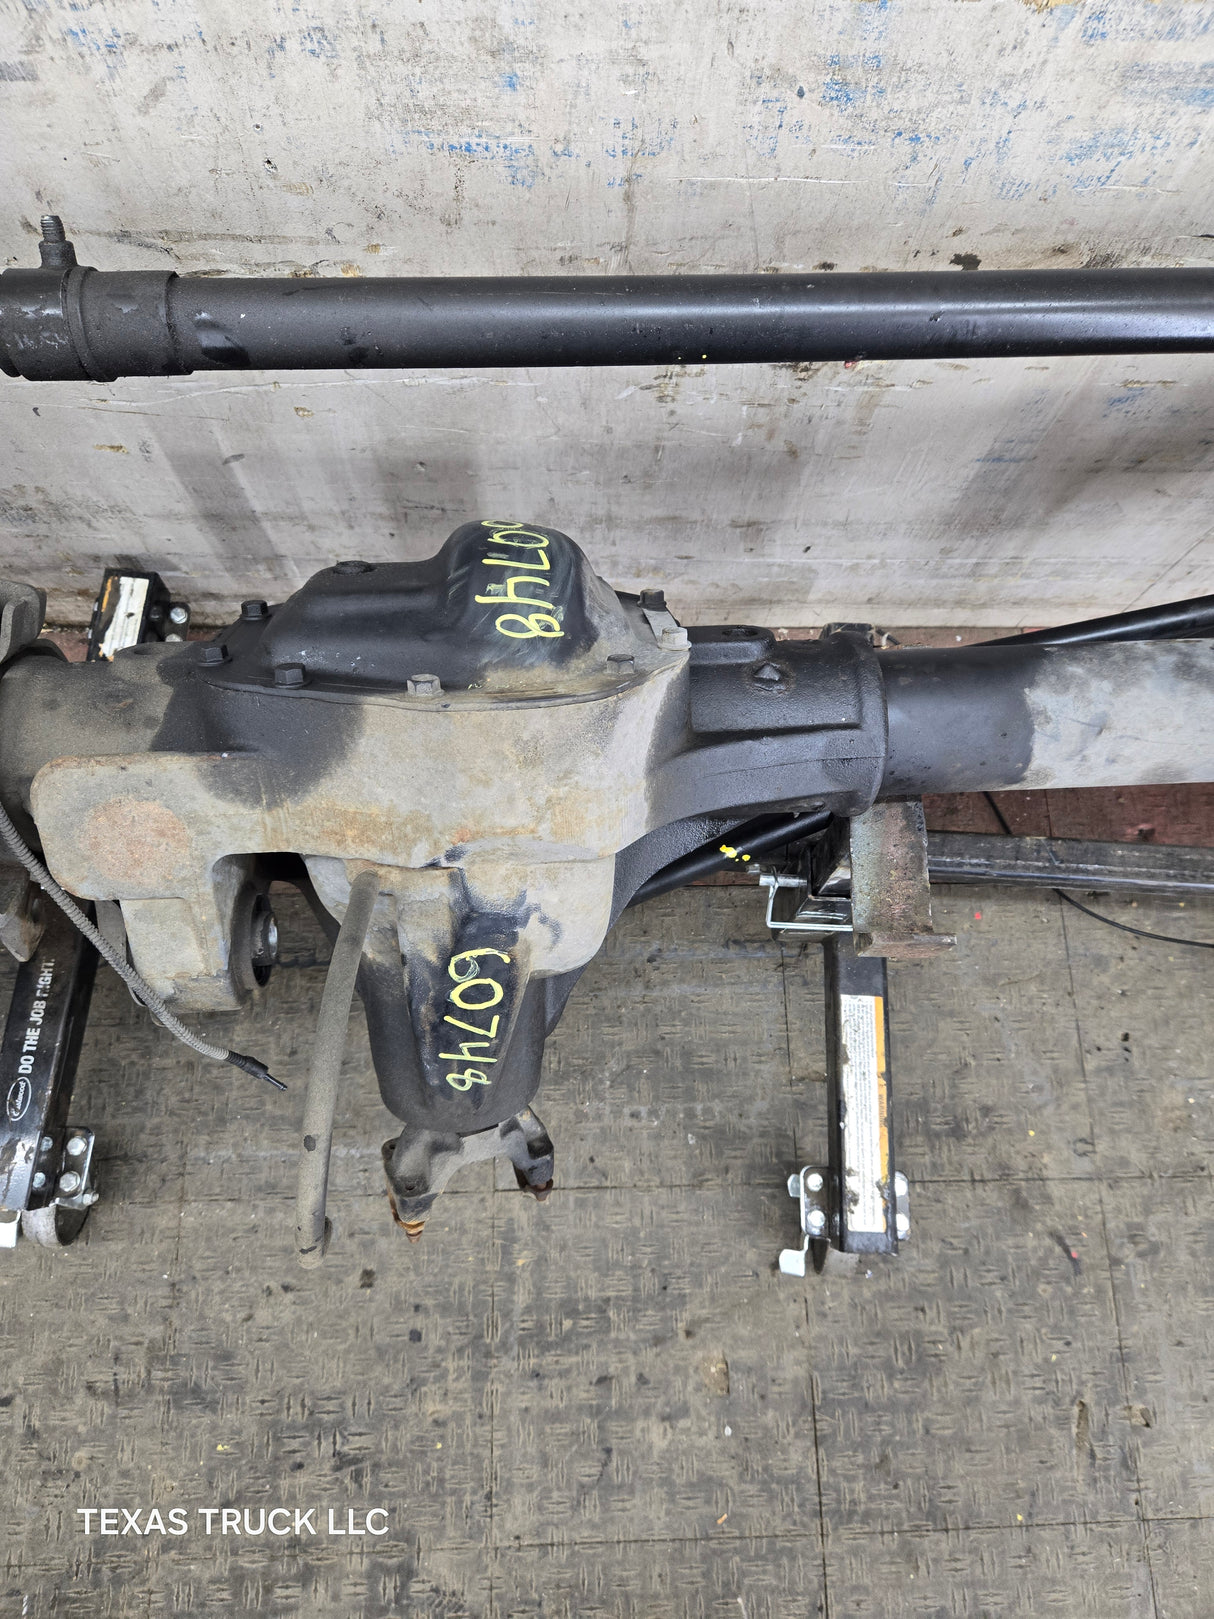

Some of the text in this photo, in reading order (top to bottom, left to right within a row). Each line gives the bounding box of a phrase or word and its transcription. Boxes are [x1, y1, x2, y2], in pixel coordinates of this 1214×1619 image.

[29, 1000, 47, 1026] JOB
[438, 948, 511, 1091] 60748
[22, 1028, 41, 1053] THE
[18, 1055, 34, 1074] DO
